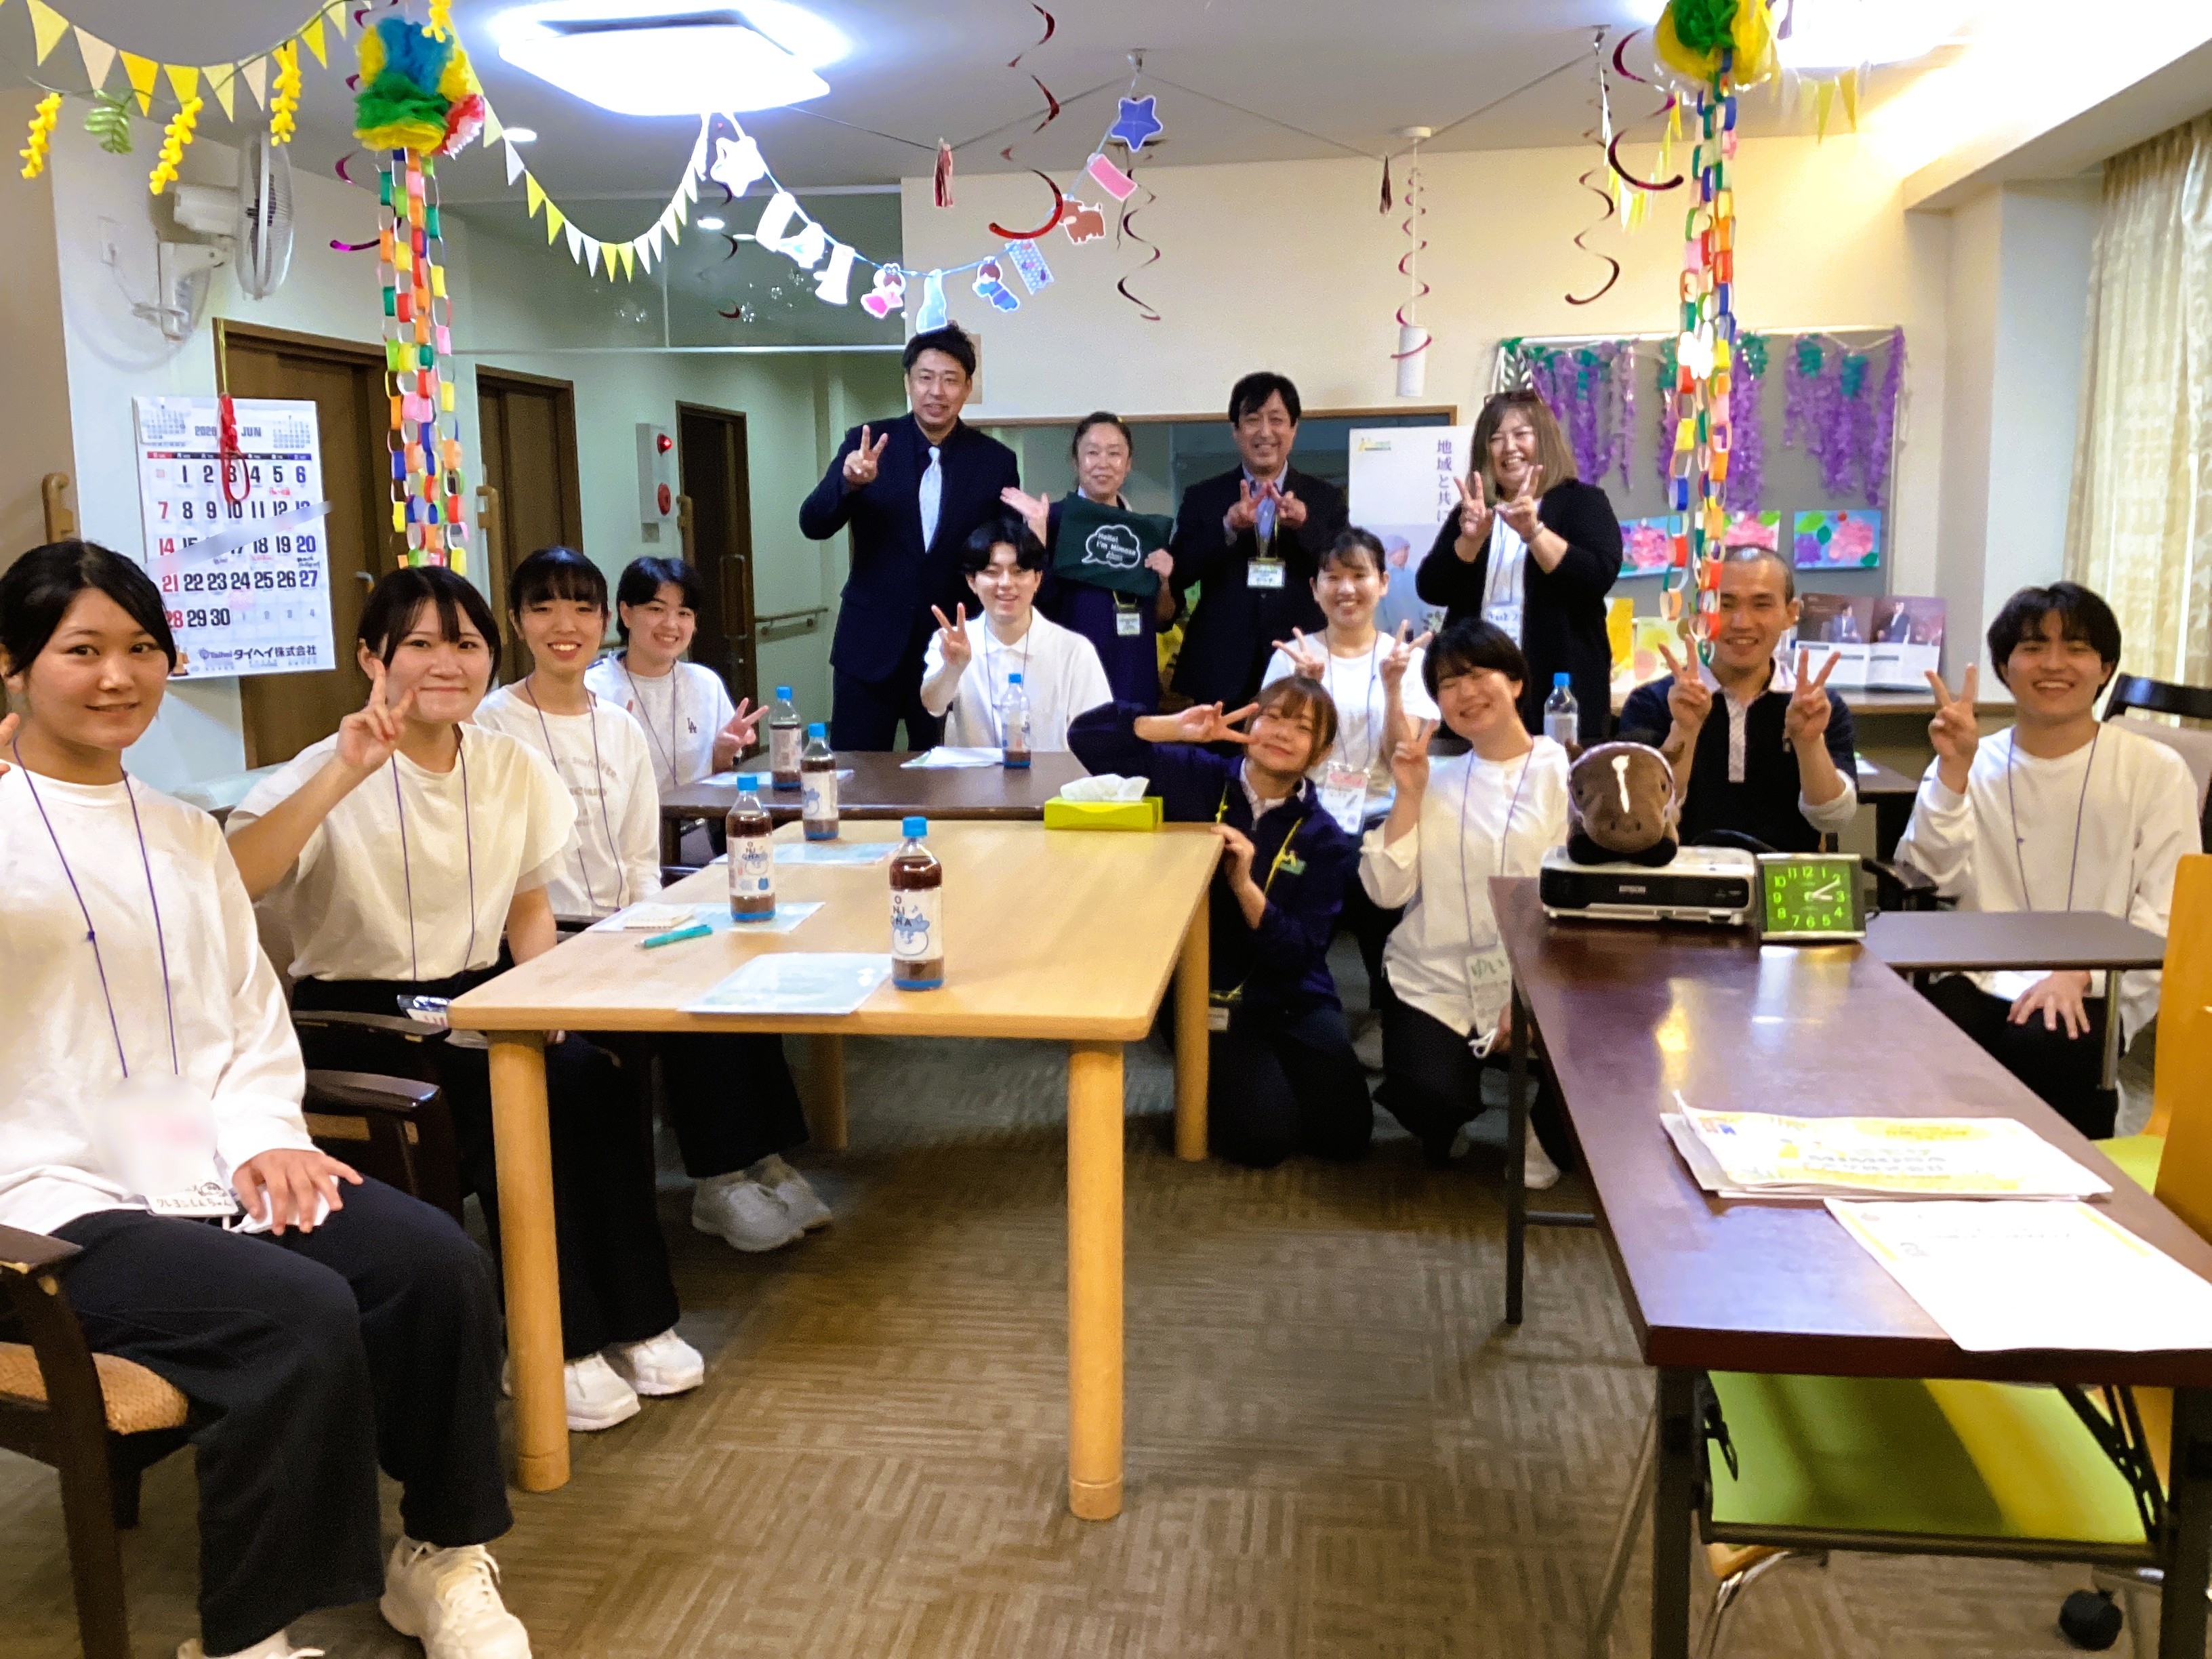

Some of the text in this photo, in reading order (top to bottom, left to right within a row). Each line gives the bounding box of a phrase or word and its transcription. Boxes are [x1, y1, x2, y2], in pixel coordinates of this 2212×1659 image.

[241, 427, 261, 436] JUN
[182, 465, 306, 484] 1 2 3 4 5 6
[158, 501, 168, 519] 7
[183, 501, 193, 519] 8
[206, 501, 217, 519] 9
[228, 501, 243, 519] 10
[251, 501, 265, 518] 11
[272, 501, 287, 516] 12
[159, 537, 175, 556] 14
[253, 537, 268, 554] 18
[276, 535, 291, 553] 19
[296, 535, 316, 553] 20
[162, 570, 318, 592] 21 22 23 24 25 26 27
[187, 609, 207, 628] 29
[210, 608, 230, 626] 30
[234, 645, 317, 660] タイヘイ株式会社
[1803, 866, 1814, 879] 12
[1821, 867, 1826, 879] 1
[1774, 876, 1786, 888] 10
[1773, 890, 1845, 904] 9 3
[1778, 906, 1843, 920] 8 4
[1792, 914, 1831, 928] 7 6 5
